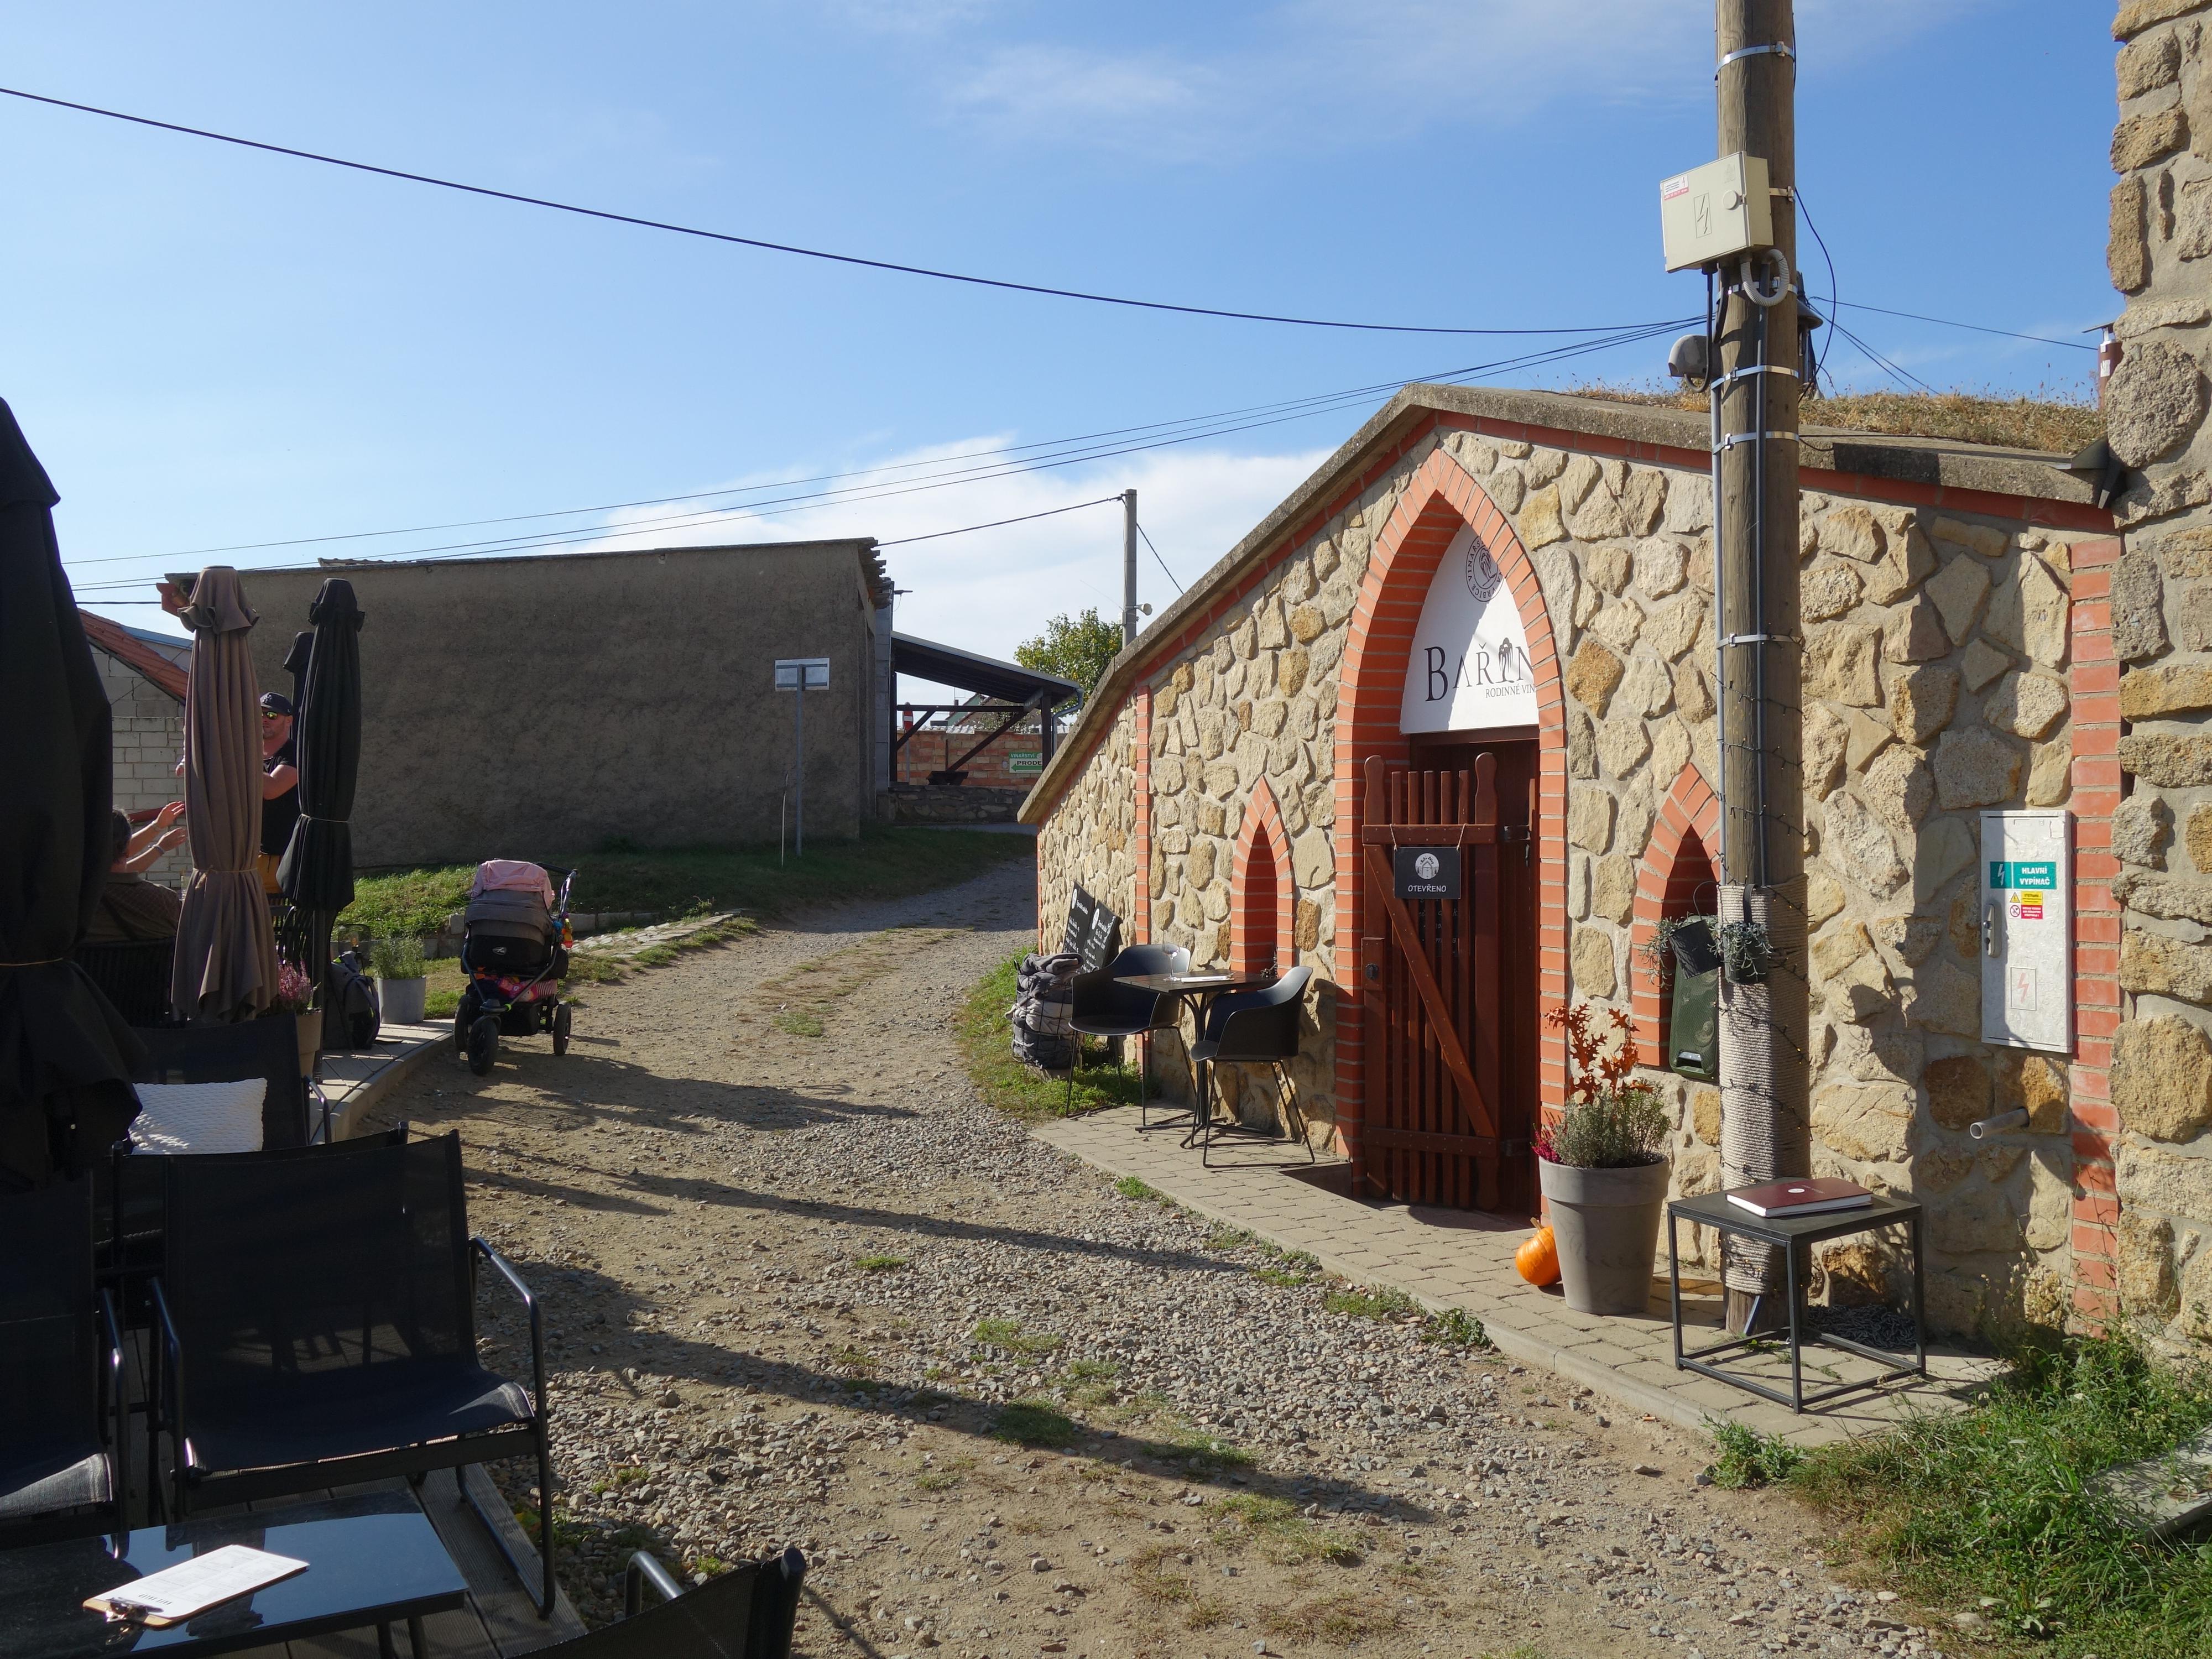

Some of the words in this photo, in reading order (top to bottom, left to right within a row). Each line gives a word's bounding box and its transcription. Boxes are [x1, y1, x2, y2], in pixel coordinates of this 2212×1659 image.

[1485, 684, 1520, 698] RODINNÉ
[2021, 865, 2047, 874] HLAVNÍ
[2019, 877, 2051, 885] VYPÍNAČ
[1407, 884, 1447, 893] OTEVŘENO
